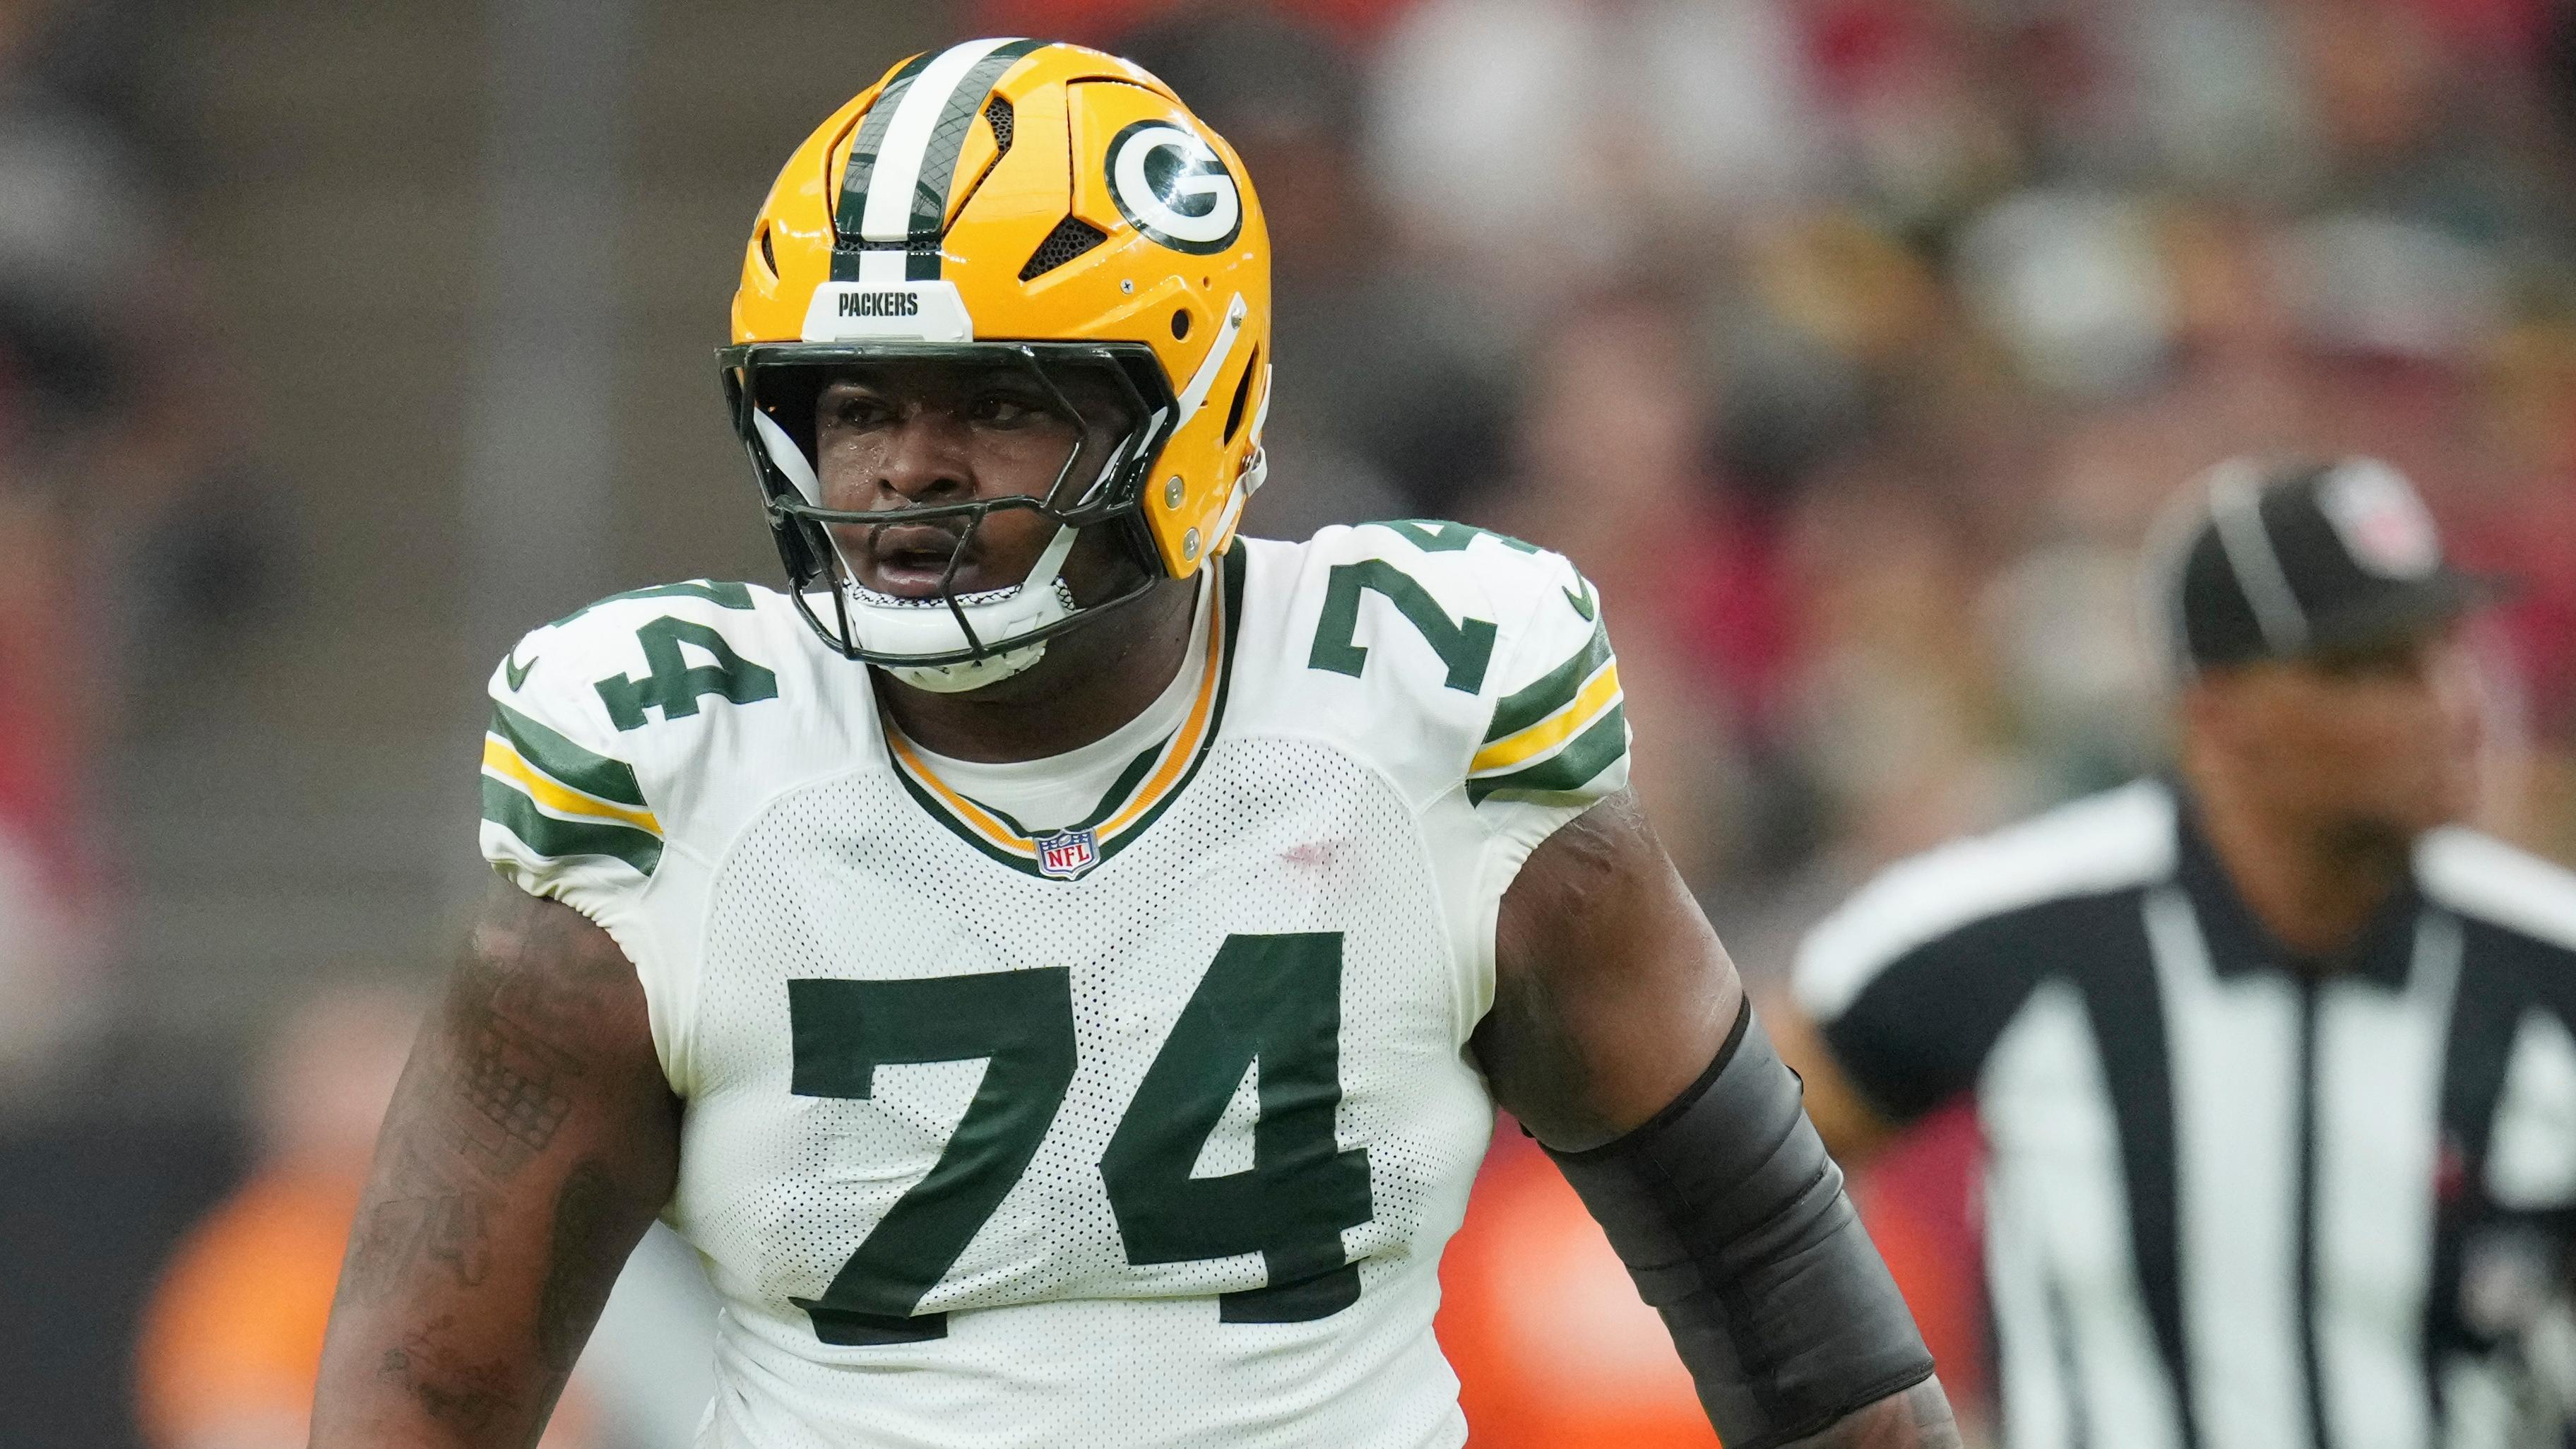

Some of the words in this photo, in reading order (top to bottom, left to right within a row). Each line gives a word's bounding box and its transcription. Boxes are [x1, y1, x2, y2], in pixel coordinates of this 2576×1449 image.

[1115, 126, 1239, 242] G
[838, 292, 918, 317] PACKERS
[1047, 845, 1089, 867] NFL
[788, 932, 1372, 1345] 74
